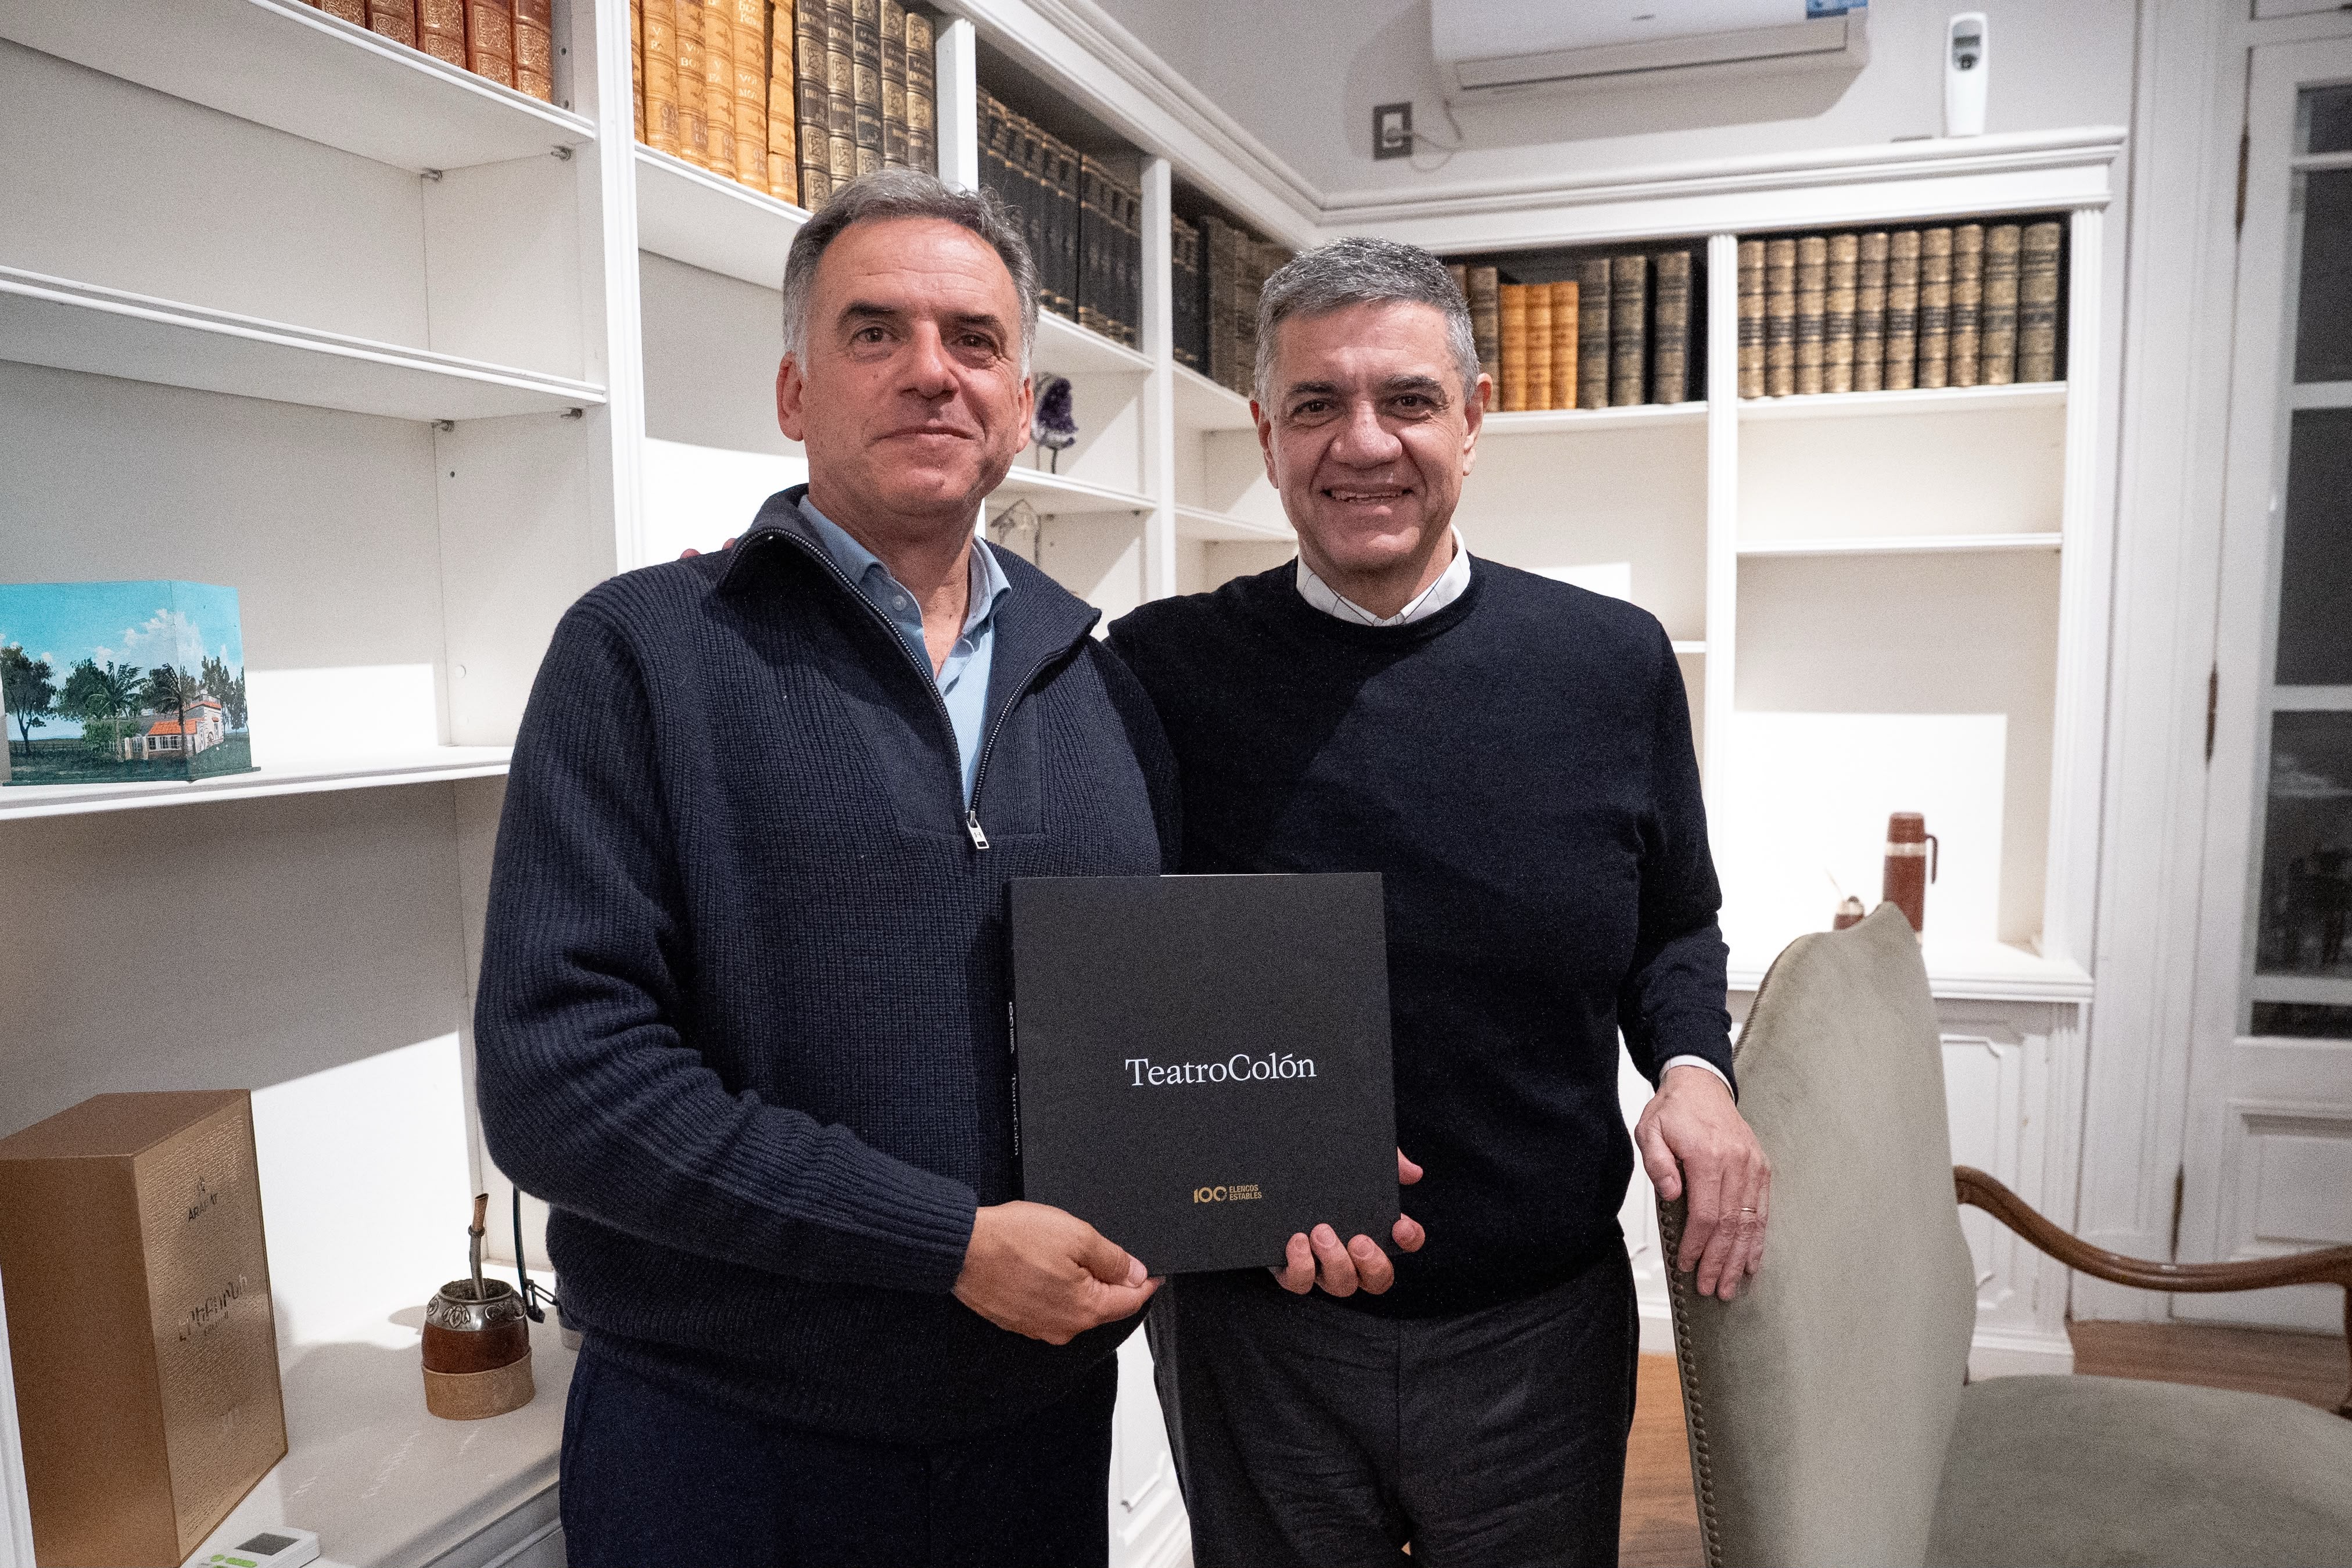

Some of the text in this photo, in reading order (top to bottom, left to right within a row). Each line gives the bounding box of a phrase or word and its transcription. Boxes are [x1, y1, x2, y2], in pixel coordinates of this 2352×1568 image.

[1125, 1052, 1317, 1086] TeatroColón
[1229, 1185, 1259, 1193] ELENCOS
[1229, 1192, 1263, 1201] ESTABLES
